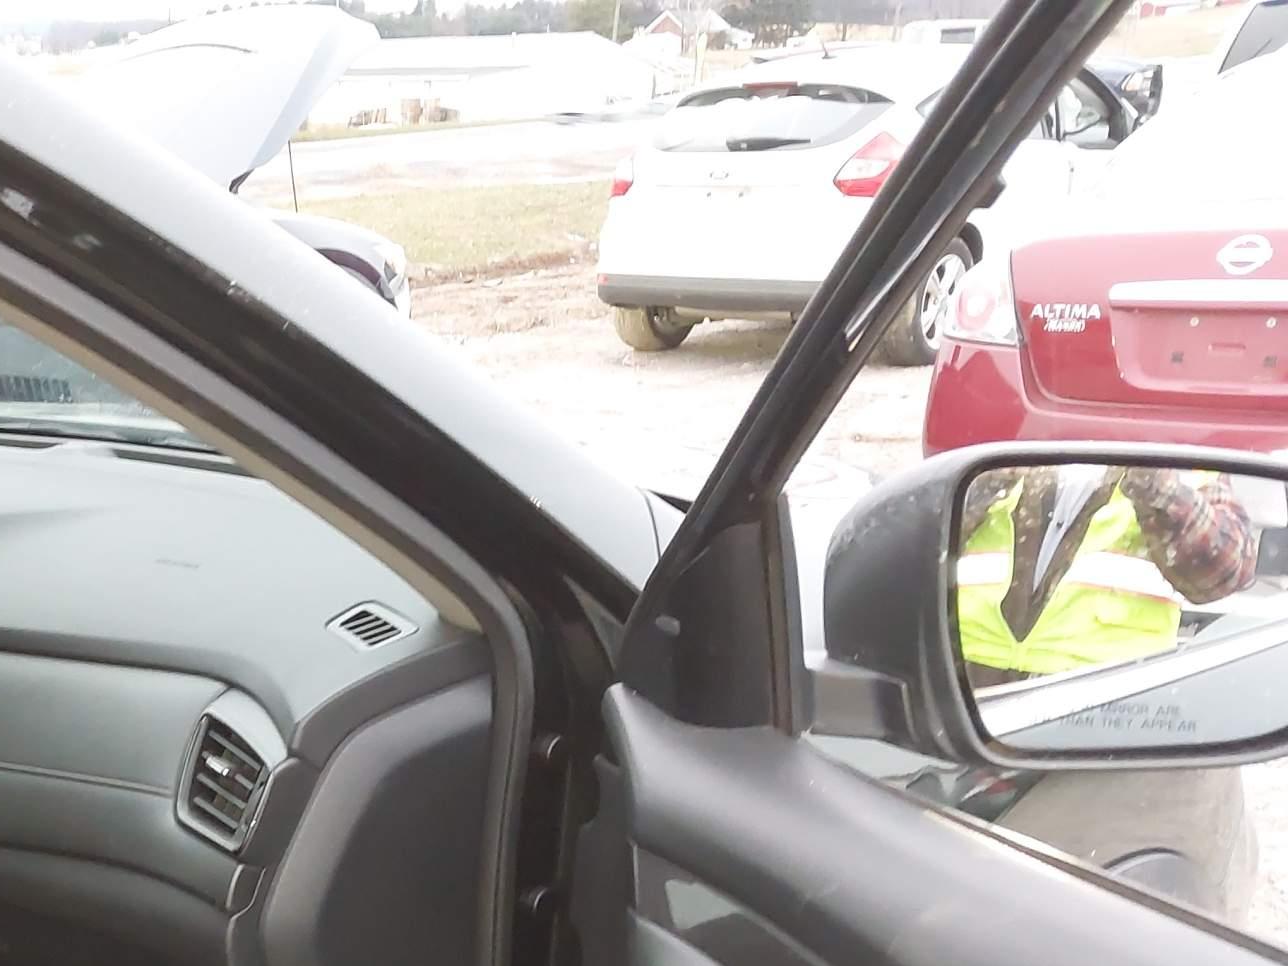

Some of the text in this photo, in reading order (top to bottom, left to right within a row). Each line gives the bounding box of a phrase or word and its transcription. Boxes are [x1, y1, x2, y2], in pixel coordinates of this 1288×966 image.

[1030, 303, 1101, 320] ALTIMA
[1155, 704, 1181, 717] ARE
[1102, 716, 1133, 730] THEY
[1139, 717, 1197, 732] APPEAR
